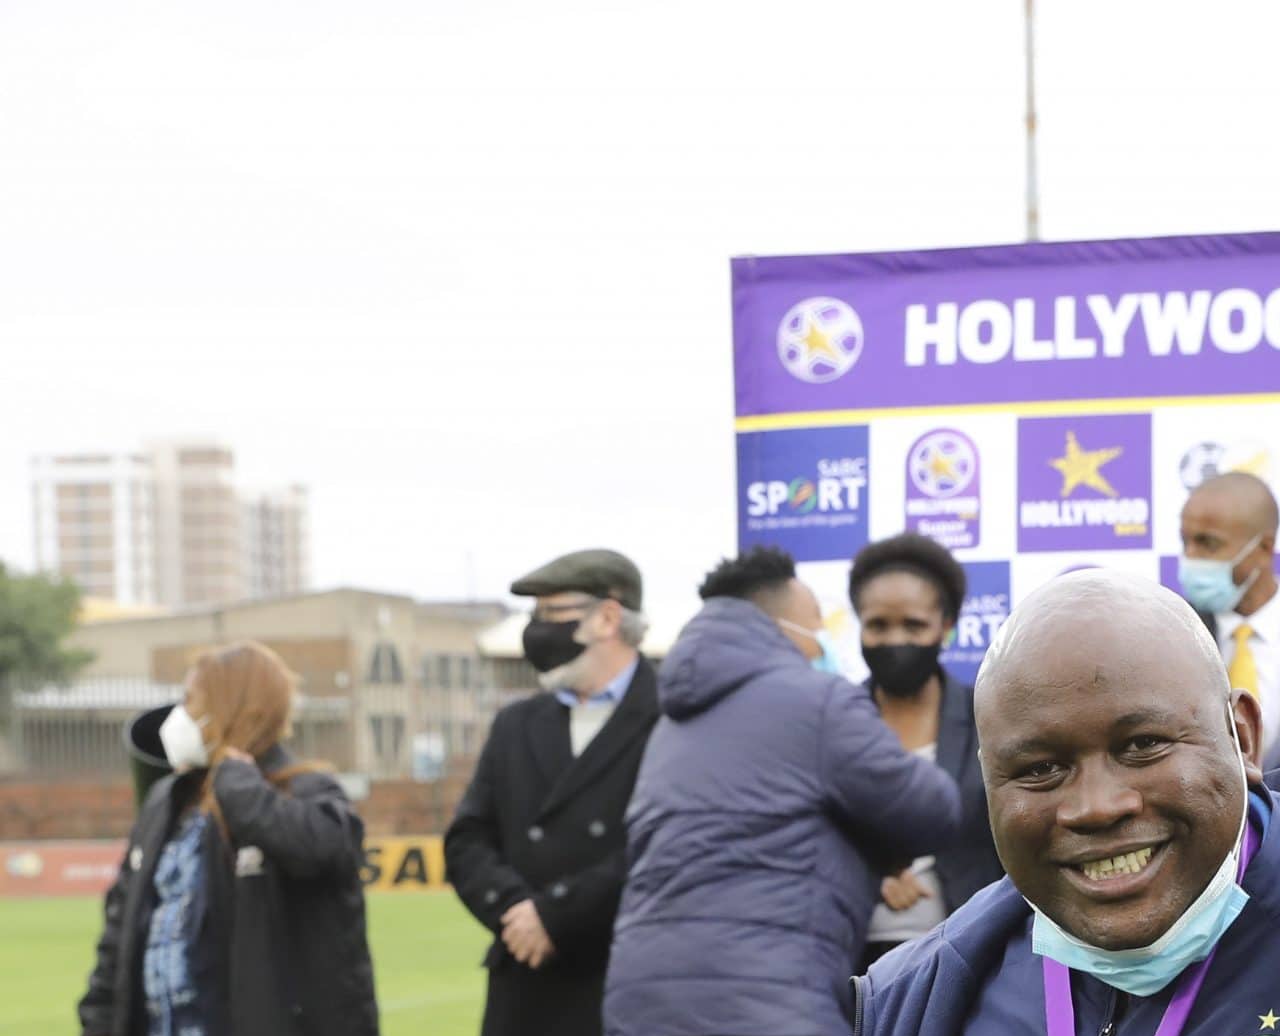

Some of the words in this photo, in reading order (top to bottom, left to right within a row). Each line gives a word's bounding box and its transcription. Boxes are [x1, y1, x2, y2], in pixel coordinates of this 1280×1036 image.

[817, 457, 866, 476] SABC
[747, 477, 867, 516] SPORT
[1020, 497, 1149, 529] HOLLYWOOD
